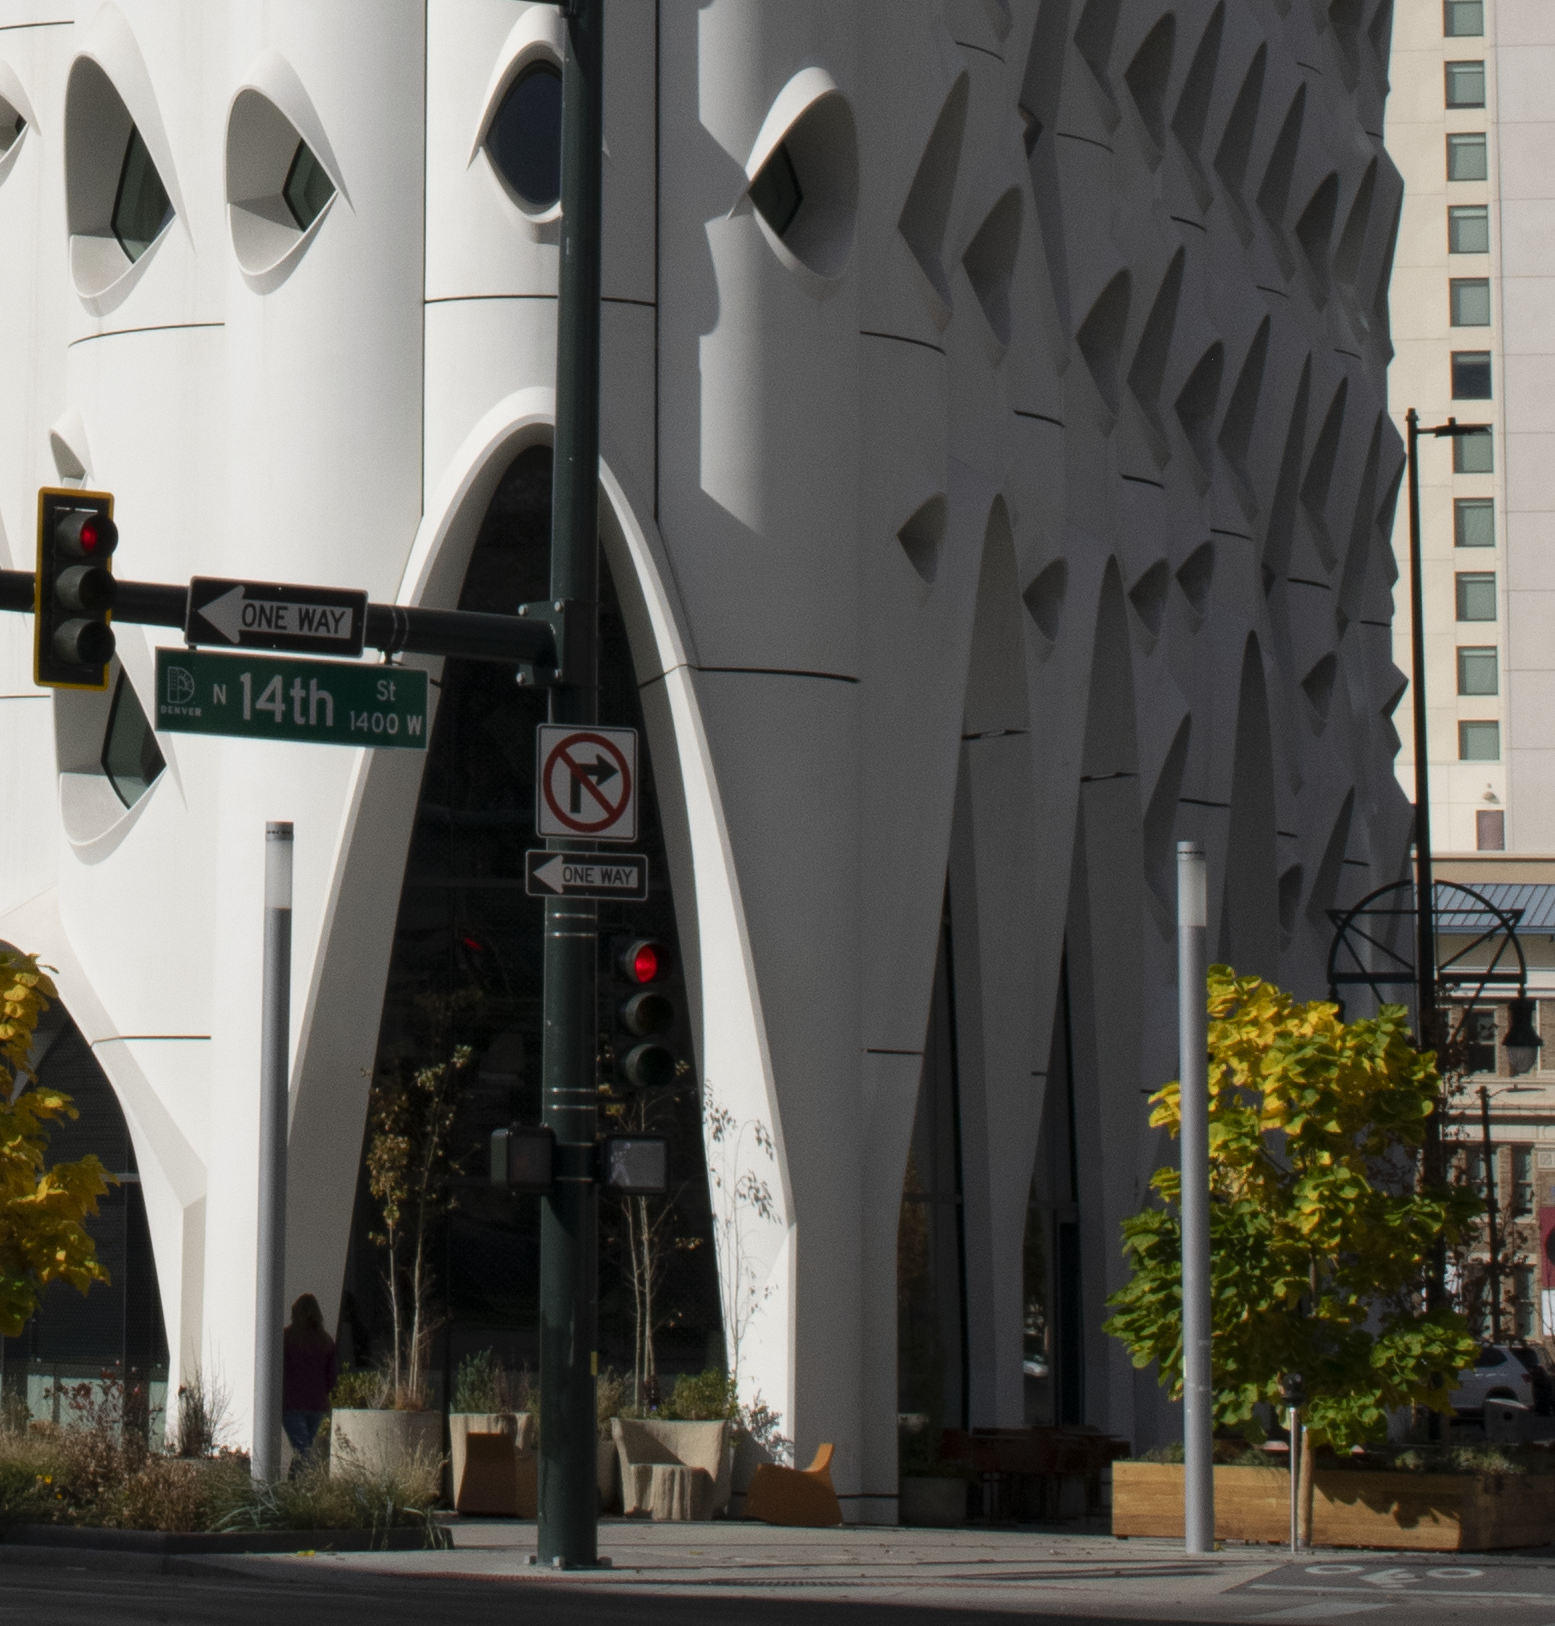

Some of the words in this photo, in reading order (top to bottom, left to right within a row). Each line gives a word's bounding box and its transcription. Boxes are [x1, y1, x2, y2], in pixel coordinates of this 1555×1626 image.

[241, 602, 288, 630] ONE
[298, 607, 346, 635] WAY
[160, 704, 202, 717] DENVER
[213, 683, 227, 705] N
[239, 672, 334, 727] 14th
[376, 679, 396, 702] St
[349, 710, 399, 735] 1400
[407, 715, 423, 736] W
[562, 866, 594, 883] ONE
[600, 868, 633, 885] WAY
